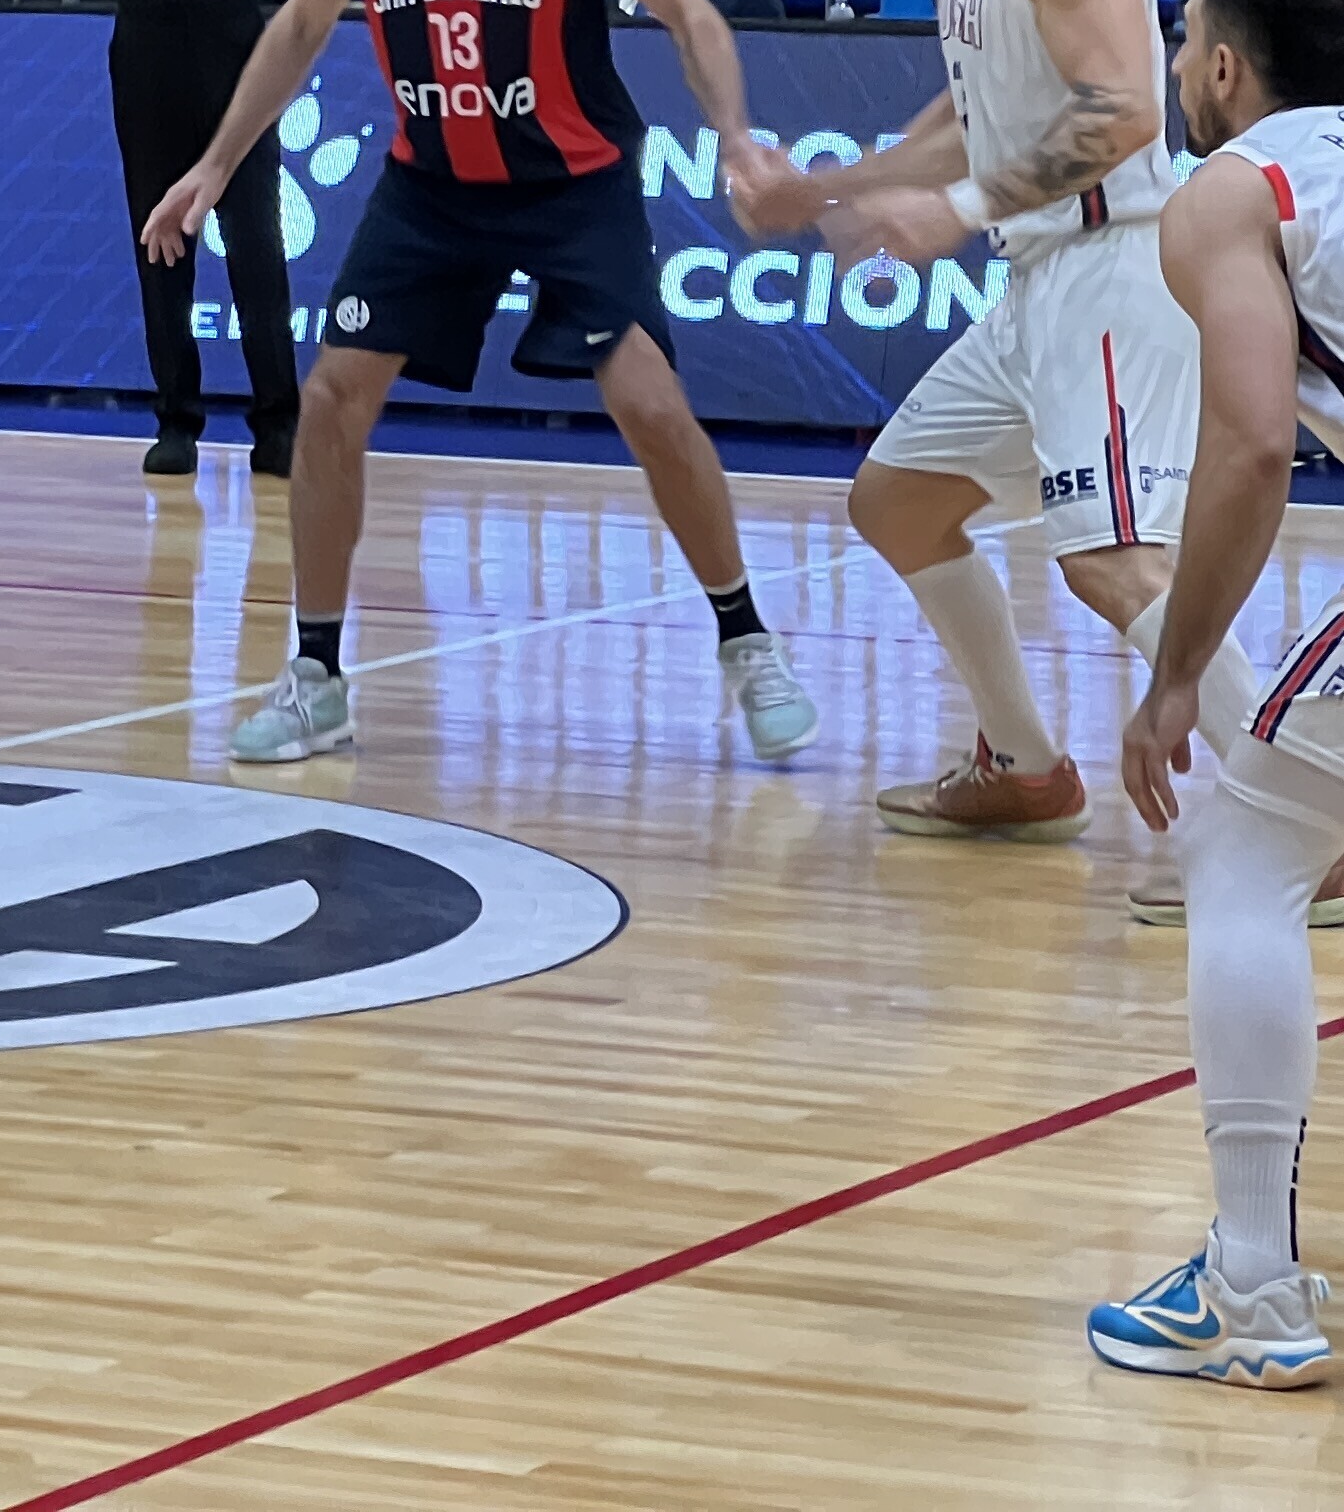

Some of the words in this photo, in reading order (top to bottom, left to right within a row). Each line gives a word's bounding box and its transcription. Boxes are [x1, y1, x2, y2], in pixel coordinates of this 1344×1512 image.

[427, 11, 480, 70] 13
[395, 76, 537, 120] enova
[1041, 467, 1097, 501] BSE
